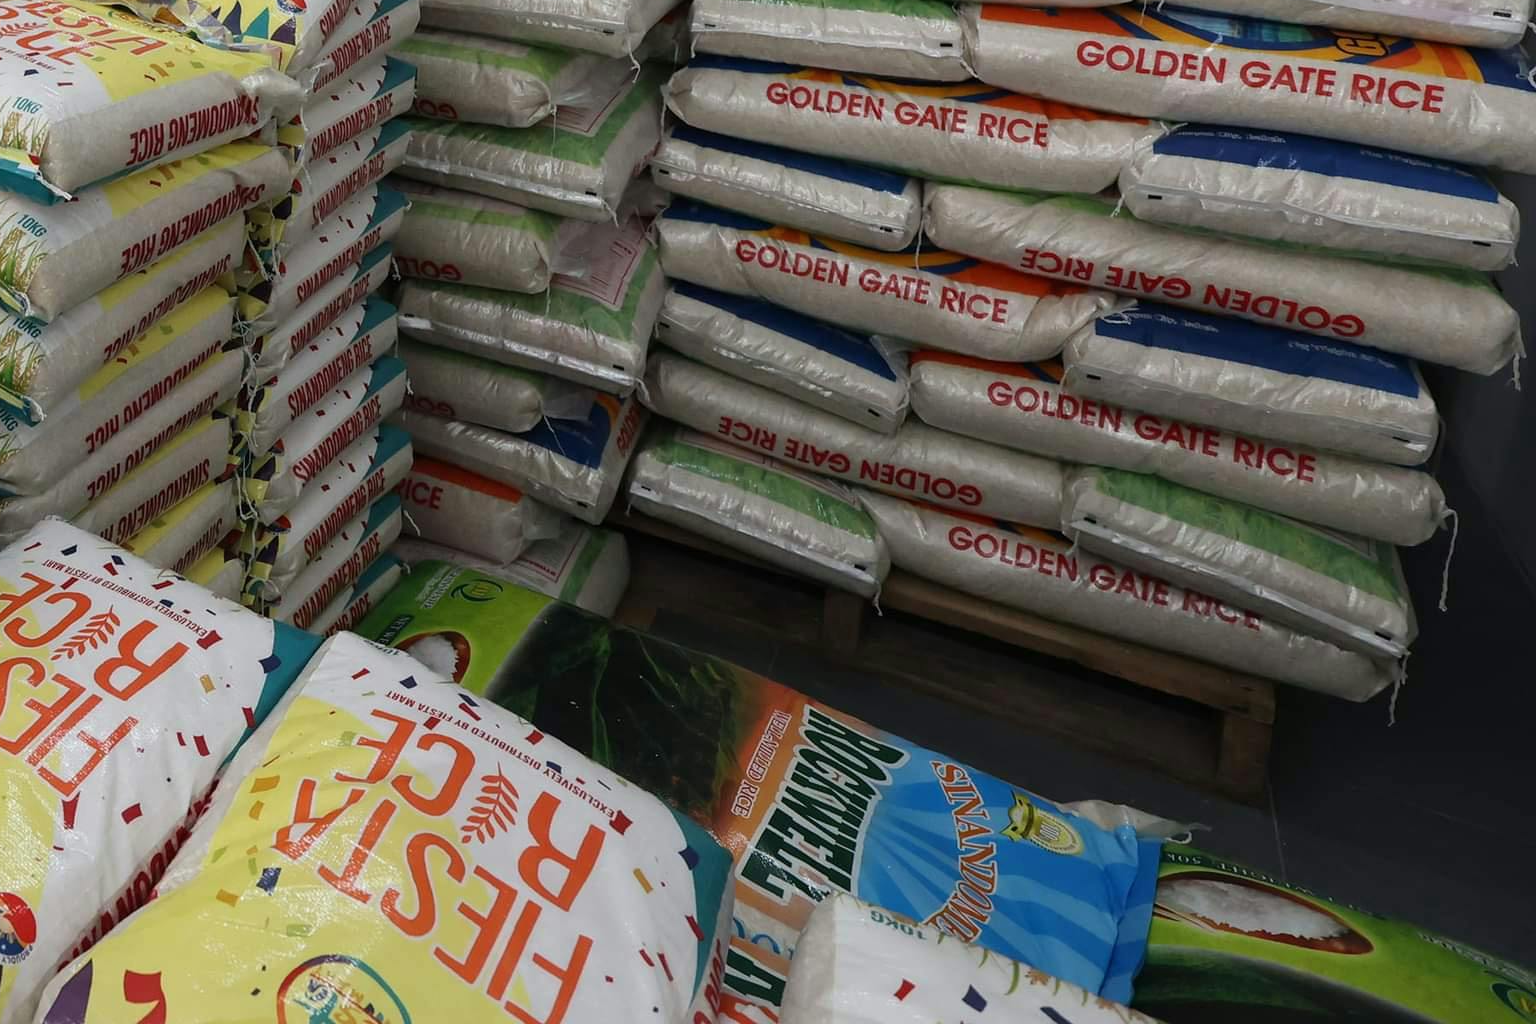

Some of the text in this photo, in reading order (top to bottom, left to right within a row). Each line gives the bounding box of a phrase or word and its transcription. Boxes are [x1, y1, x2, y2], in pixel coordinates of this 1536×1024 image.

[373, 15, 392, 48] RICE
[10, 94, 45, 115] 10KG
[1075, 38, 1446, 115] GOLDEN GATE RICE
[126, 121, 164, 167] RICE
[310, 92, 394, 162] SINANDOMENG RICE
[764, 79, 1050, 149] GOLDEN GATE RICE
[15, 212, 49, 238] 10KG
[733, 238, 1010, 326] GOLDEN GATE RICE
[1019, 247, 1096, 281] RICE
[1104, 262, 1192, 300] GATE
[1202, 282, 1366, 338] GOLDEN
[287, 334, 372, 420] SINANDOMENG RICE
[292, 395, 382, 482] SINANDOMENG RICE
[716, 415, 984, 508] GOLDEN GATE RICE
[986, 380, 1318, 484] GOLDEN GATE RICE
[303, 467, 386, 565] SINANDOMENG RICE
[42, 559, 65, 570] MART
[64, 566, 94, 578] FIESTA
[93, 575, 104, 585] BY
[293, 532, 381, 630] SINANDOMENG RICE
[946, 524, 1264, 633] GOLDEN GATE RICE
[153, 604, 208, 637] EXCLUSIVELY
[386, 690, 615, 819] EXCLUSIVELY DISTRIBUTED BY FIESTA MART
[731, 708, 792, 819] WELL-MILLED RICE
[735, 702, 912, 907] ROCKWELL
[920, 758, 1001, 945] SINANDOME
[270, 776, 595, 1024] FIESTA
[869, 909, 927, 942] 10KG
